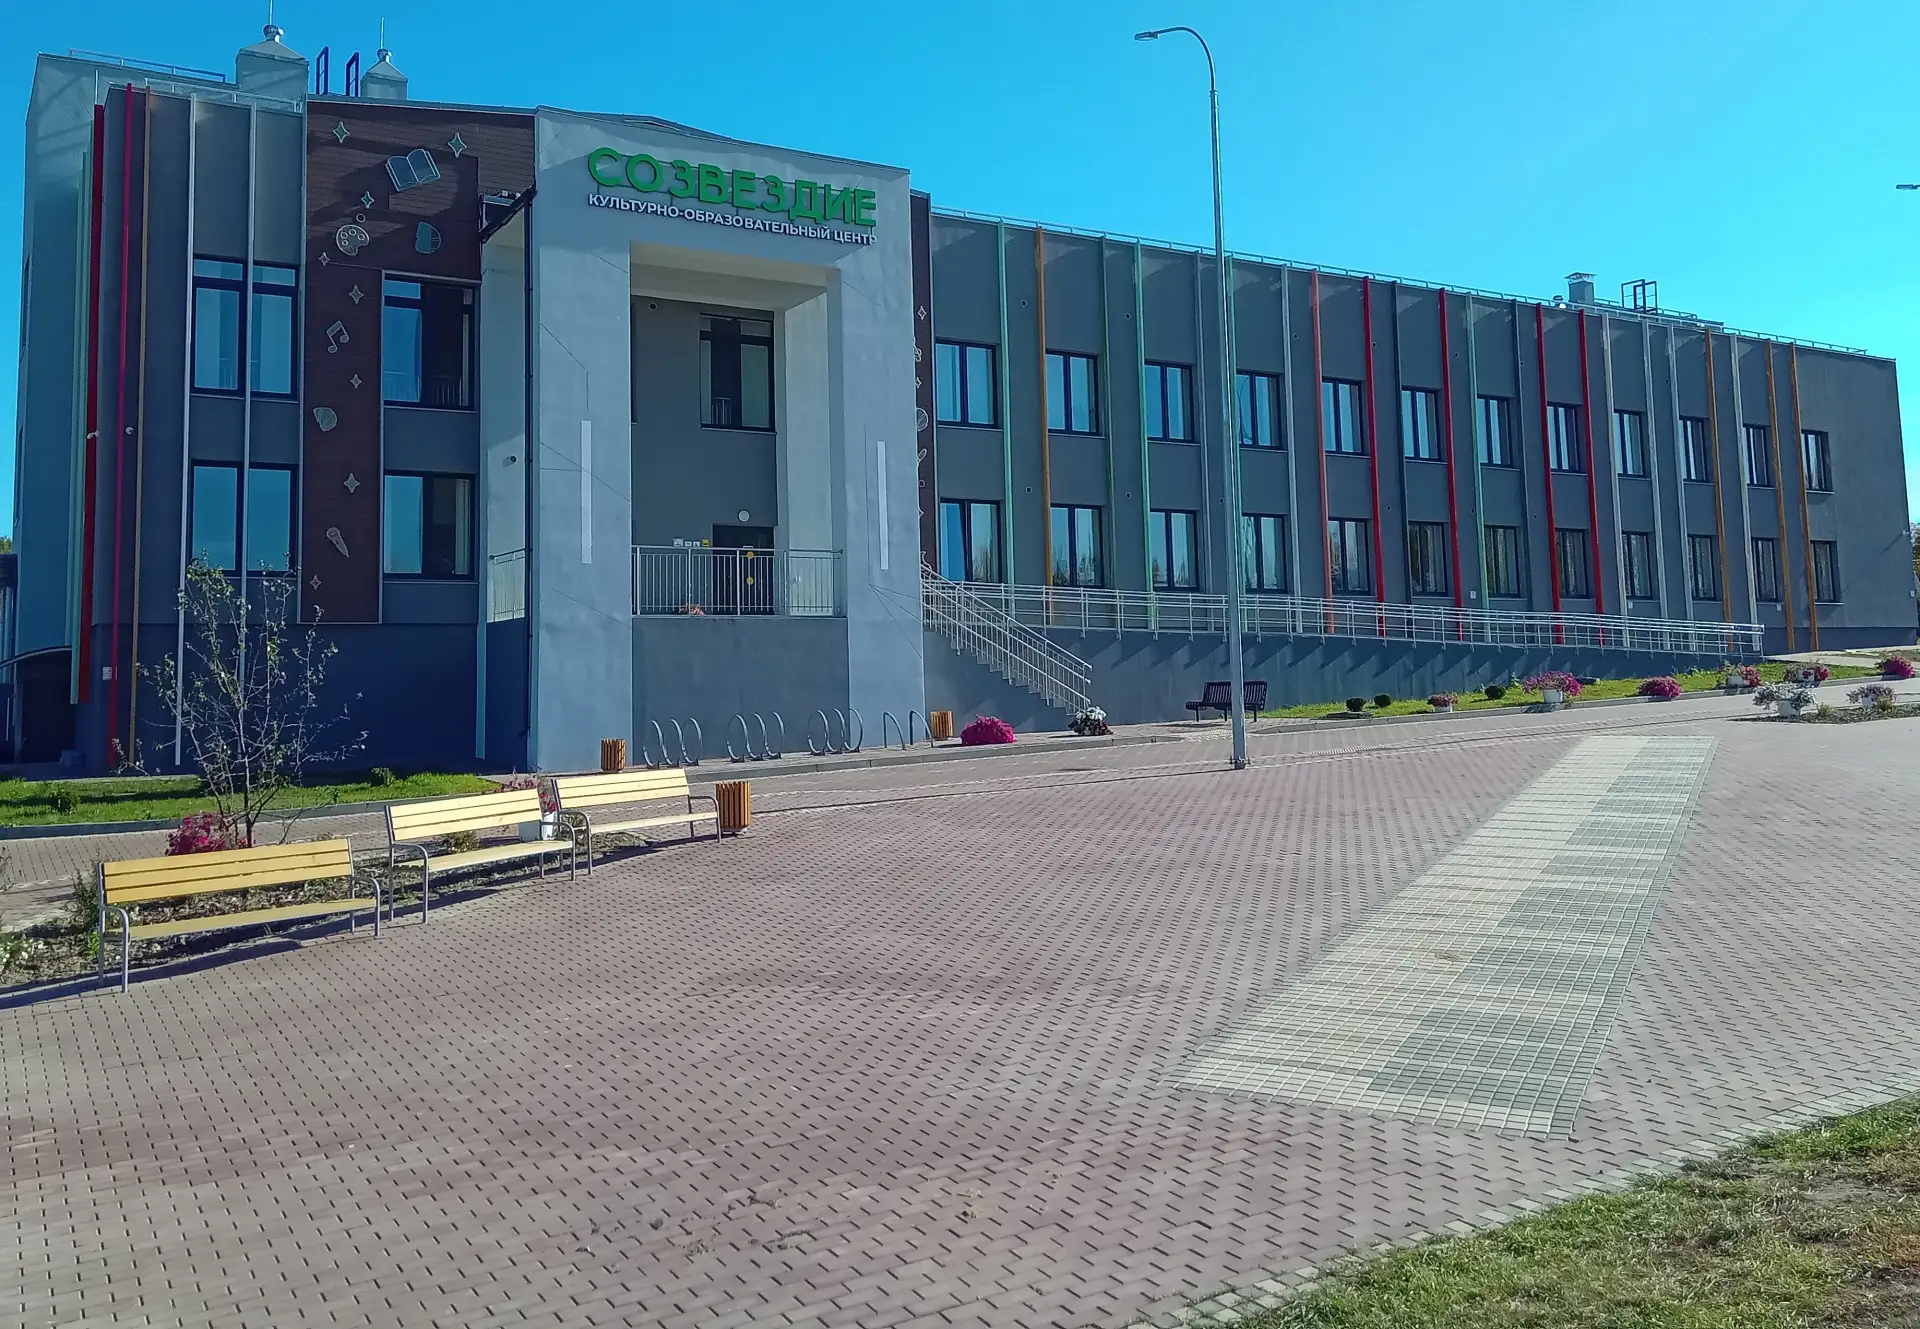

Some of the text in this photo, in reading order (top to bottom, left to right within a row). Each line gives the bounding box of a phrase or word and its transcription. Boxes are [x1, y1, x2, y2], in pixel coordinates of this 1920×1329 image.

[588, 147, 877, 226] СОЗВЕЗДИЕ
[588, 193, 877, 246] КУЛЬТУРНО-ОБРАЗОВАТЕЛЬНЫЙ ЦЕНТР
